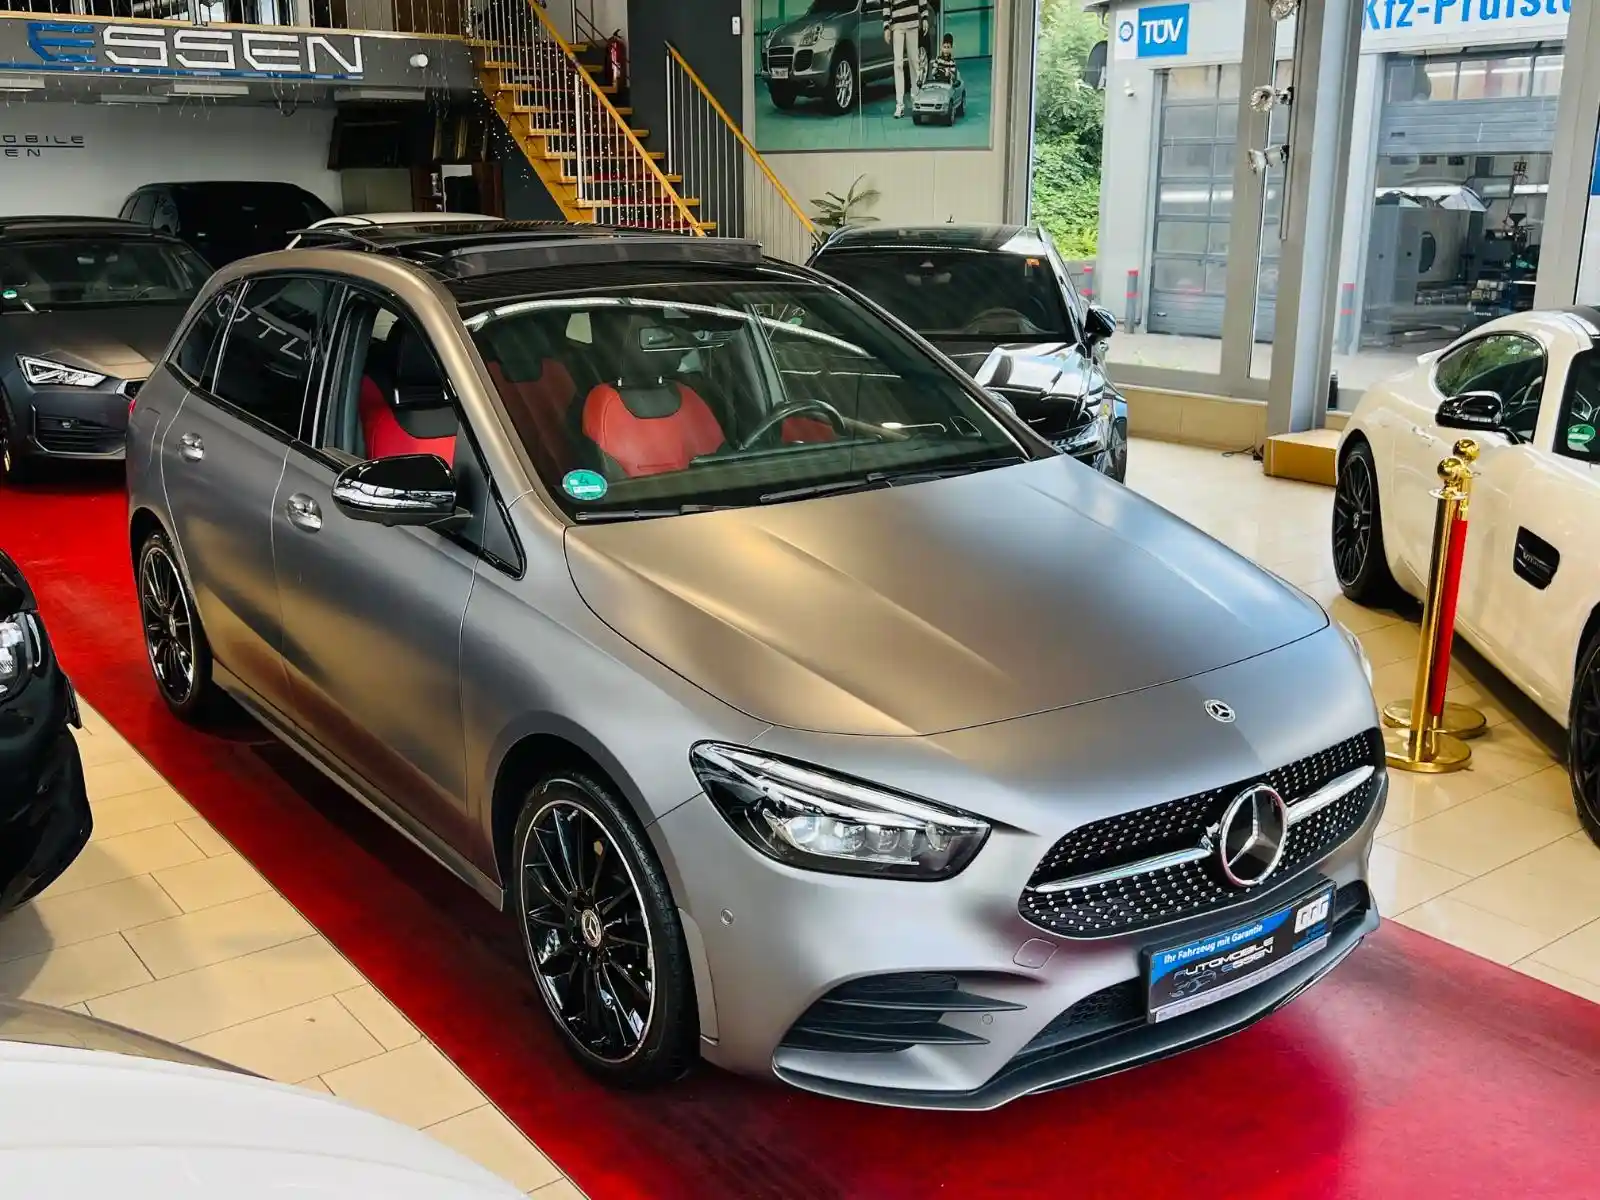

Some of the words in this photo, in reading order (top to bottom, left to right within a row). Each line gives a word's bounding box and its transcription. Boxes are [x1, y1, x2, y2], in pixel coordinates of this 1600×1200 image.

[28, 22, 364, 74] ESSEN
[1141, 16, 1184, 44] TÜV
[1173, 936, 1275, 980] AUTOMOBILE
[1178, 941, 1216, 961] Fahrzeug
[1216, 935, 1231, 948] mit
[1231, 923, 1263, 943] Garantie
